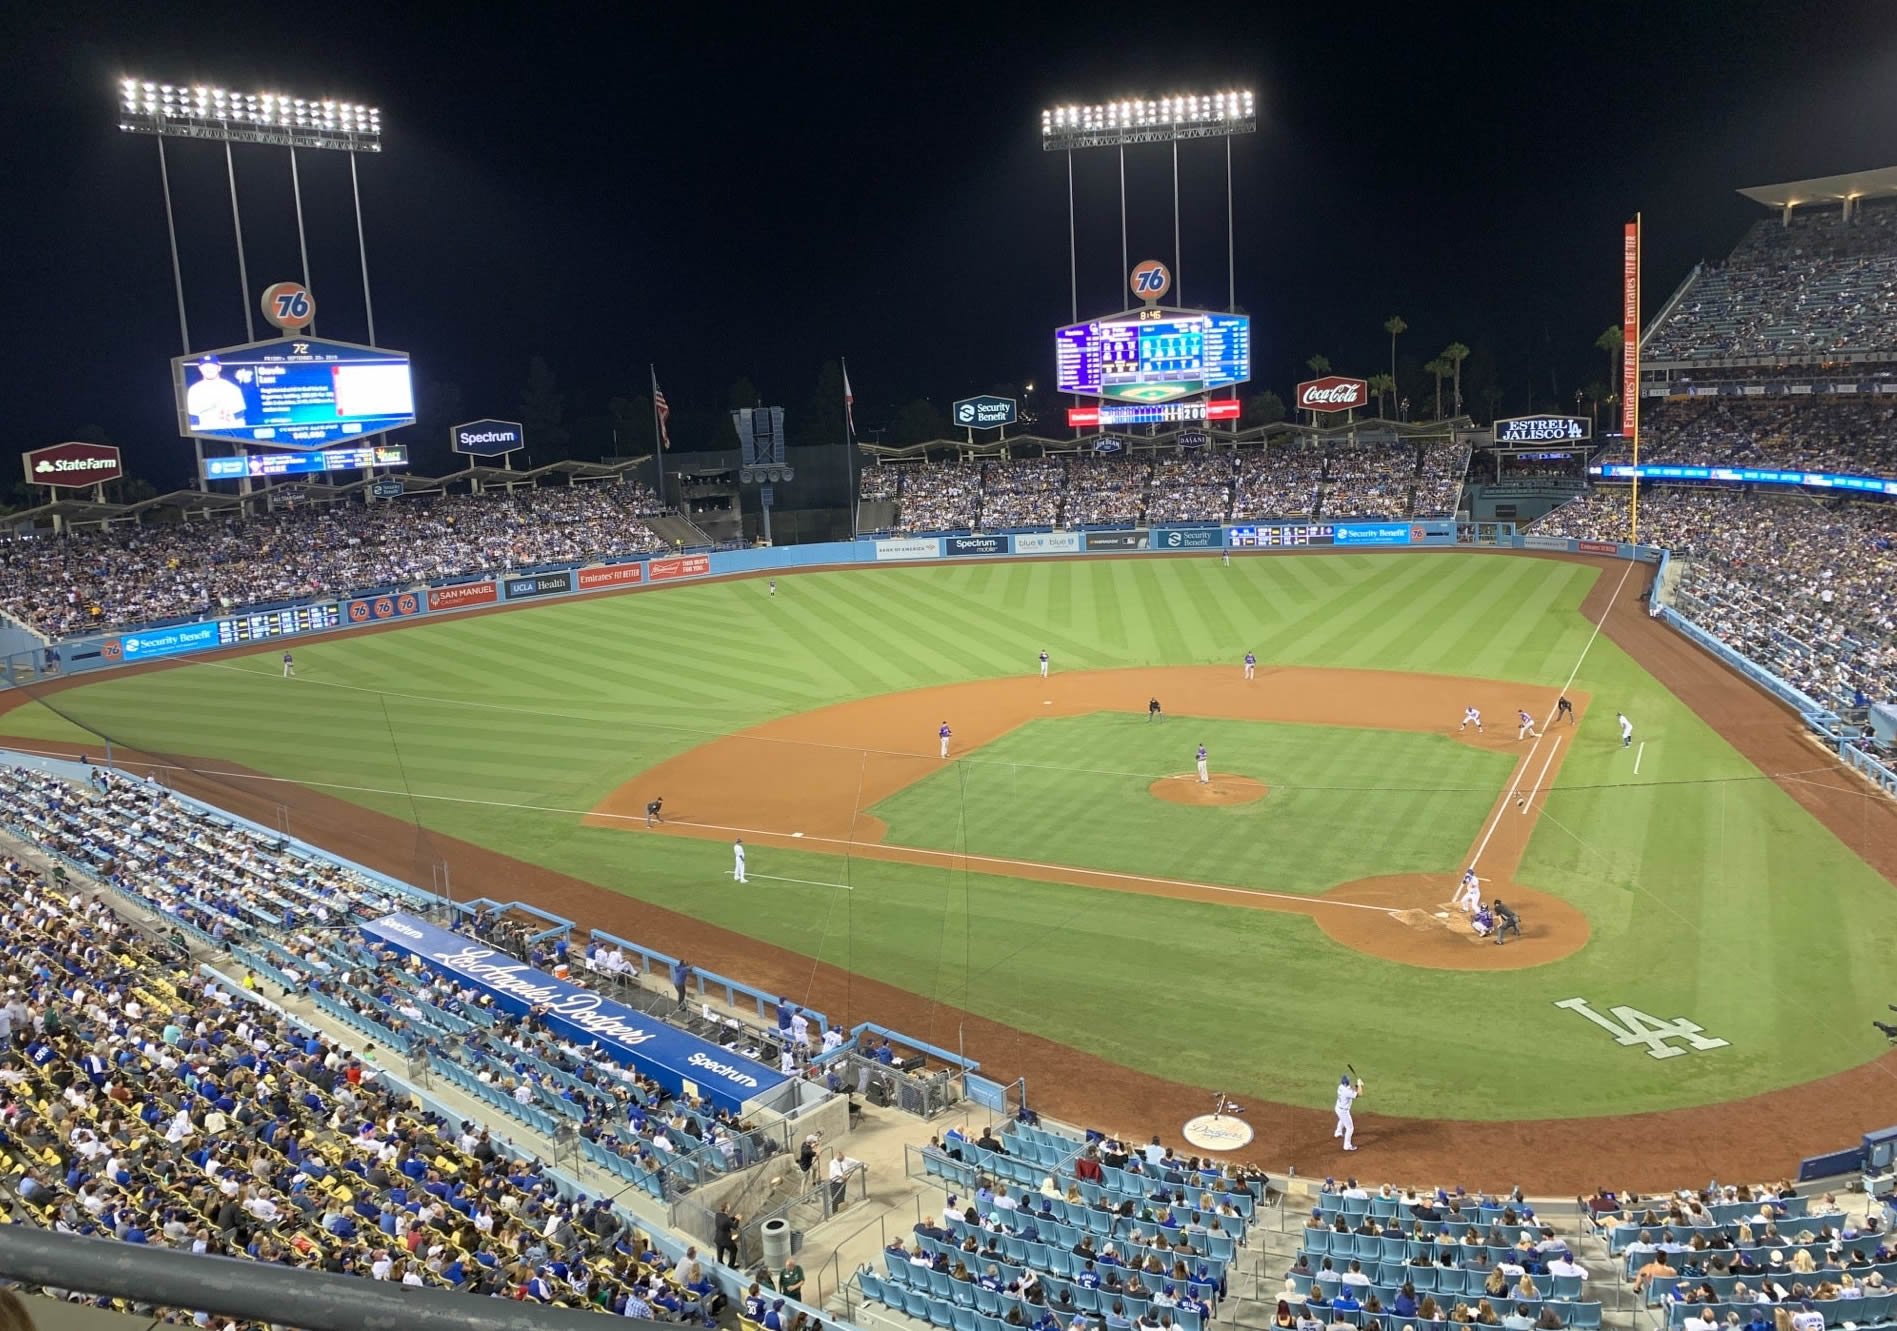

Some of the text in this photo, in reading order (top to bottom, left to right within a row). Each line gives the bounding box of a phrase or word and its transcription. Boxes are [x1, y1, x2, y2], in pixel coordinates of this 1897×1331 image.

[1136, 267, 1165, 293] 76
[276, 292, 310, 319] 76
[1625, 277, 1636, 325] Emirates
[1139, 310, 1161, 320] 8:46
[292, 343, 309, 354] 72
[1302, 384, 1361, 404] Coca-Cola
[977, 402, 1010, 412] Security
[1624, 382, 1635, 428] Emirates
[978, 411, 1006, 421] Benefit
[1184, 408, 1191, 419] 2
[1192, 407, 1199, 419] 0
[1509, 420, 1567, 431] ESTREL
[460, 432, 514, 446] Spectrum
[1503, 429, 1564, 440] JALISCO
[1183, 532, 1211, 541] Security
[1349, 529, 1407, 538] Security Benefit
[956, 539, 996, 548] Spectrum
[1019, 539, 1036, 547] blue
[1050, 538, 1066, 546] blue
[1184, 539, 1208, 547] Benefit
[580, 573, 614, 584] Emirates
[513, 578, 566, 593] UCLA Health
[440, 585, 494, 600] SAN MANUEL
[379, 602, 390, 613] 76
[402, 599, 413, 609] 76
[354, 605, 366, 616] 76
[140, 633, 177, 649] Security
[180, 629, 211, 643] Benefit
[106, 646, 119, 656] 76
[485, 965, 563, 1007] Angeles
[548, 993, 656, 1045] Dodgers
[1553, 997, 1732, 1061] LA
[688, 1052, 755, 1088] Spectrum
